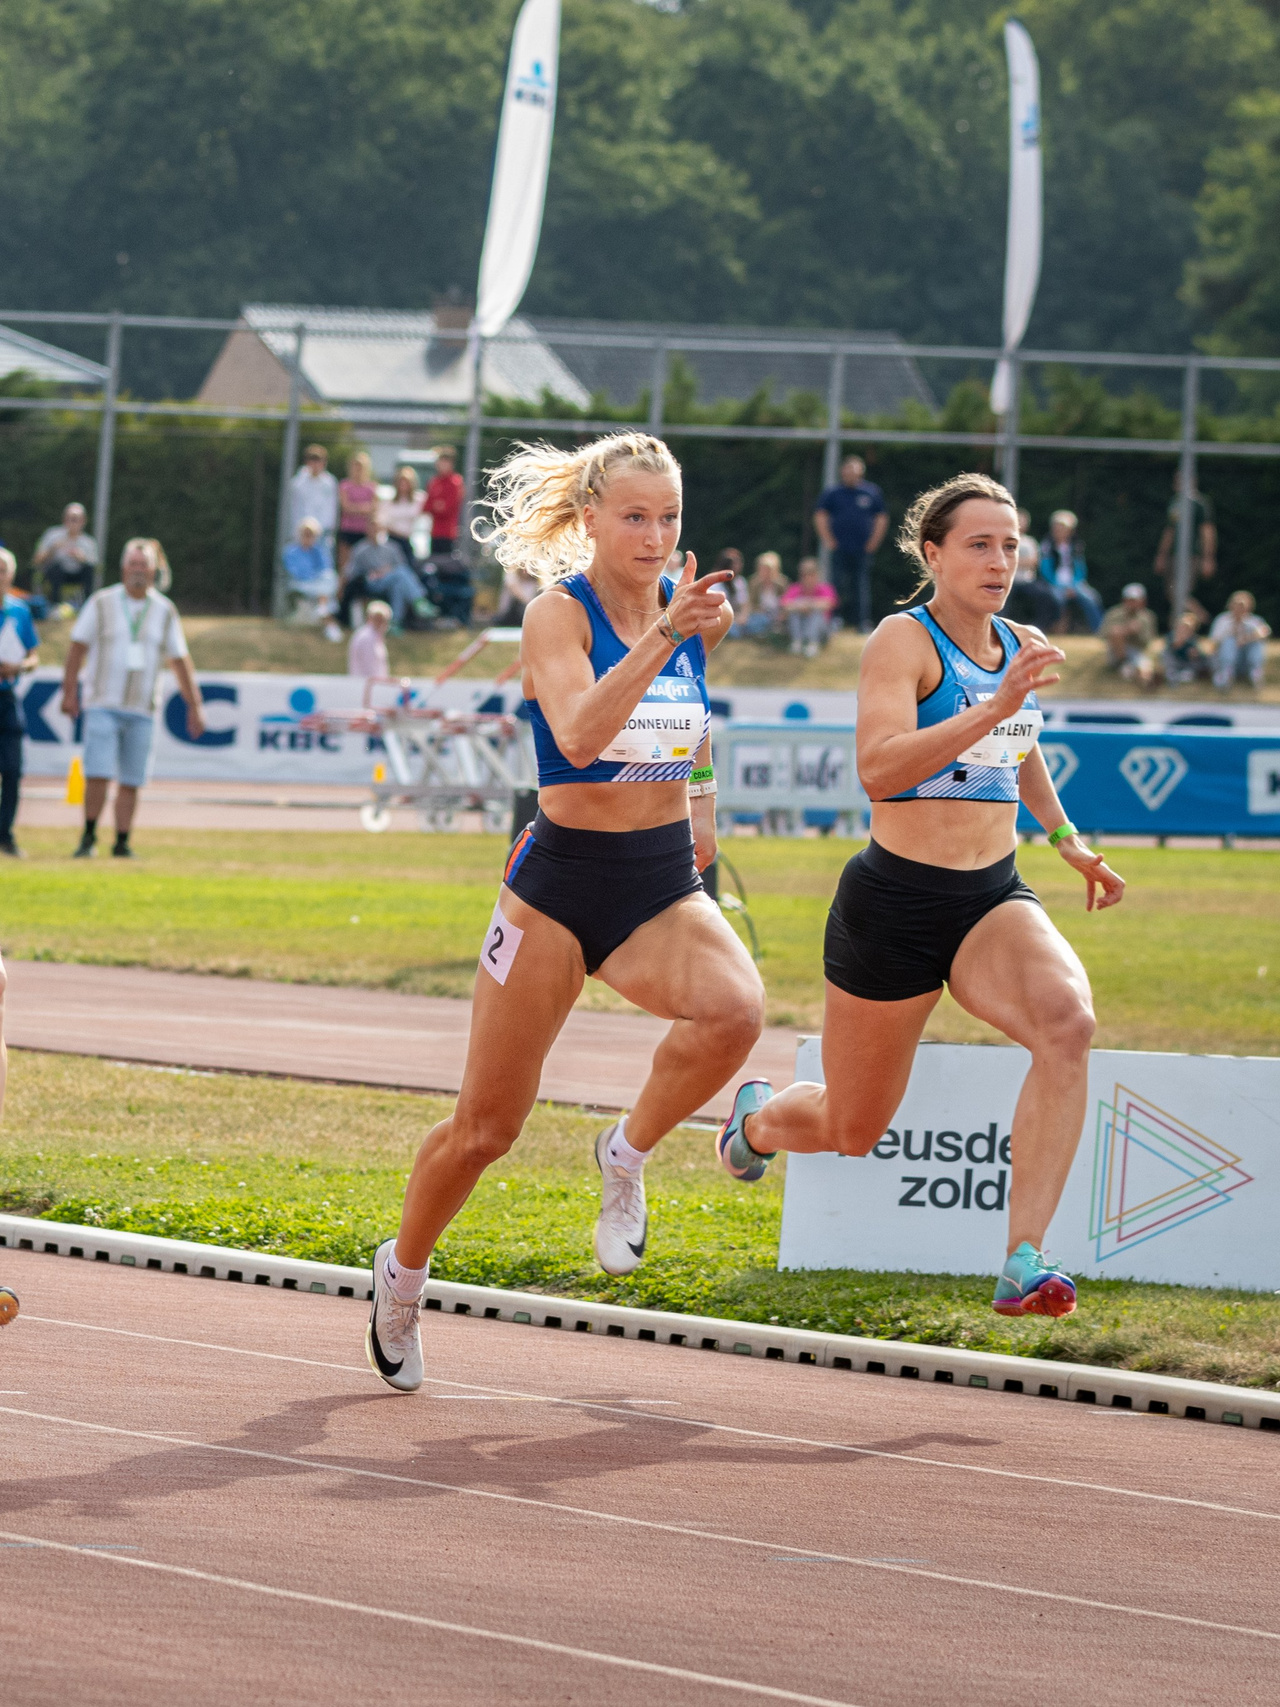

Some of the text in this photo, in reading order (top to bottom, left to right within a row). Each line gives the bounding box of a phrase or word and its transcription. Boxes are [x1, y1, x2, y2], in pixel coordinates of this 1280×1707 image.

[1006, 723, 1033, 736] LENT
[258, 730, 342, 751] KBC
[693, 770, 713, 780] COACH
[487, 926, 504, 965] 2
[898, 1168, 1011, 1211] zold
